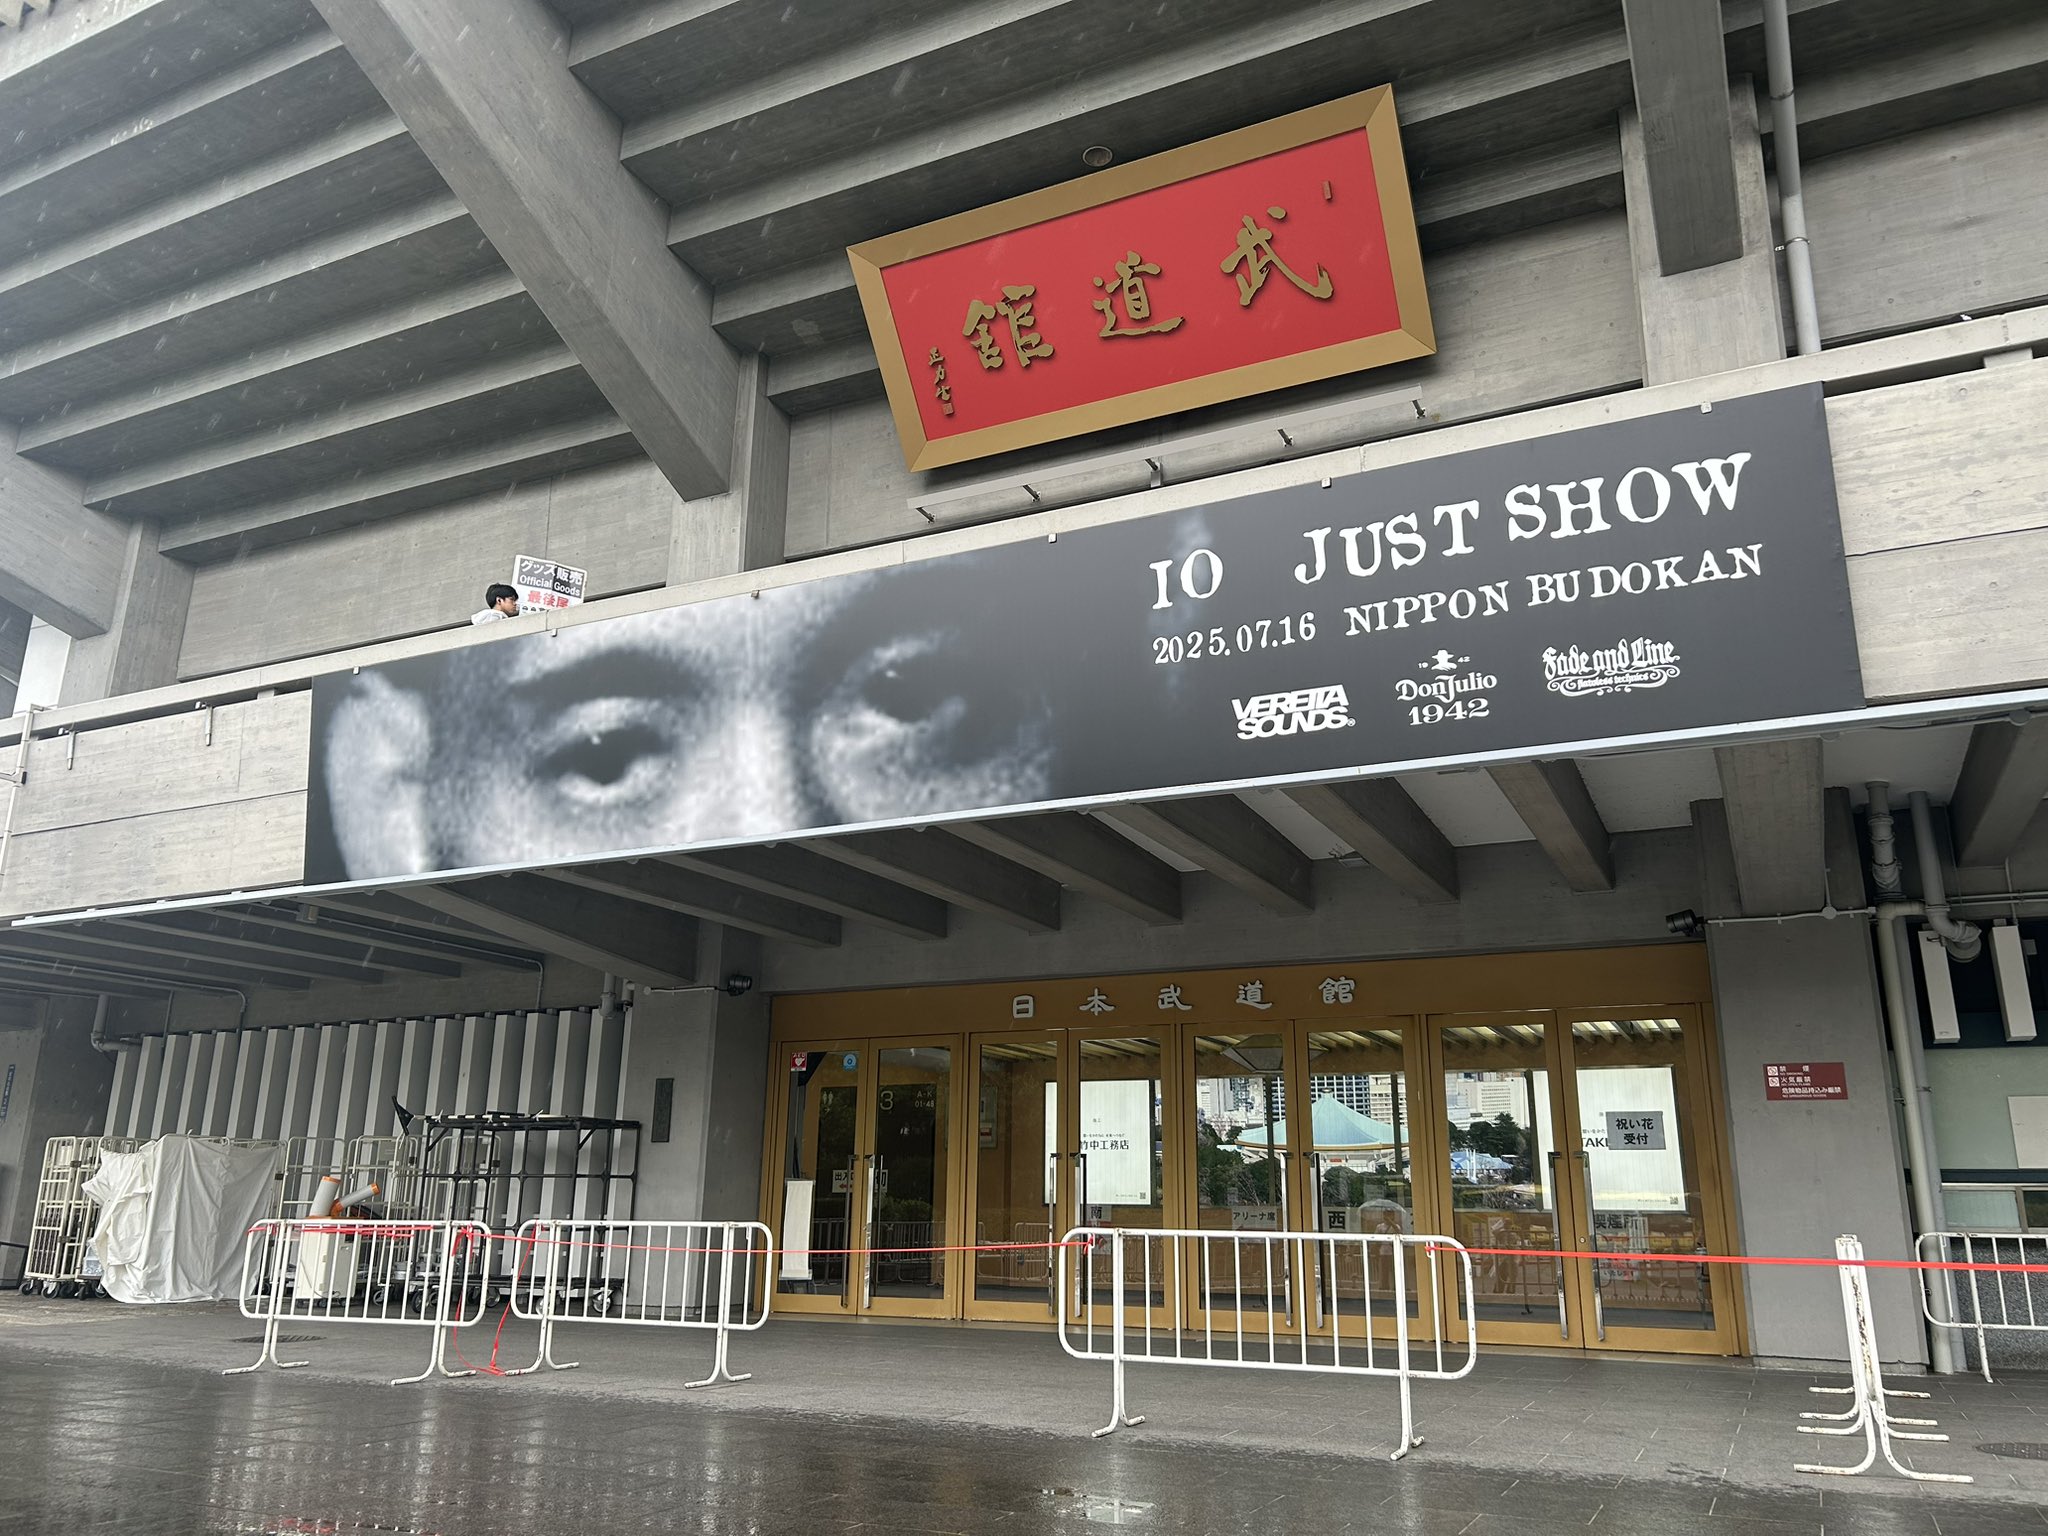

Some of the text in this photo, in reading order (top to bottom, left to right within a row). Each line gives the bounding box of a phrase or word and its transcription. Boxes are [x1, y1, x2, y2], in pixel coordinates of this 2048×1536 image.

[1294, 500, 1480, 585] JUST
[1504, 452, 1752, 541] SHOW
[520, 560, 584, 585] グッズ販売
[519, 575, 581, 597] Official Goods
[1152, 543, 1763, 664] 2025.07.16 NIPPON BUDOKAN
[1542, 645, 1593, 681] Fade
[1592, 638, 1630, 676] and
[1407, 697, 1490, 726] 1942
[1012, 976, 1356, 1019] 日本武道館
[879, 1090, 894, 1110] 3
[1615, 1118, 1654, 1130] 祝い花
[1623, 1133, 1649, 1145] 受付
[1232, 1210, 1276, 1222] アリーナ席
[1327, 1210, 1347, 1230] 西
